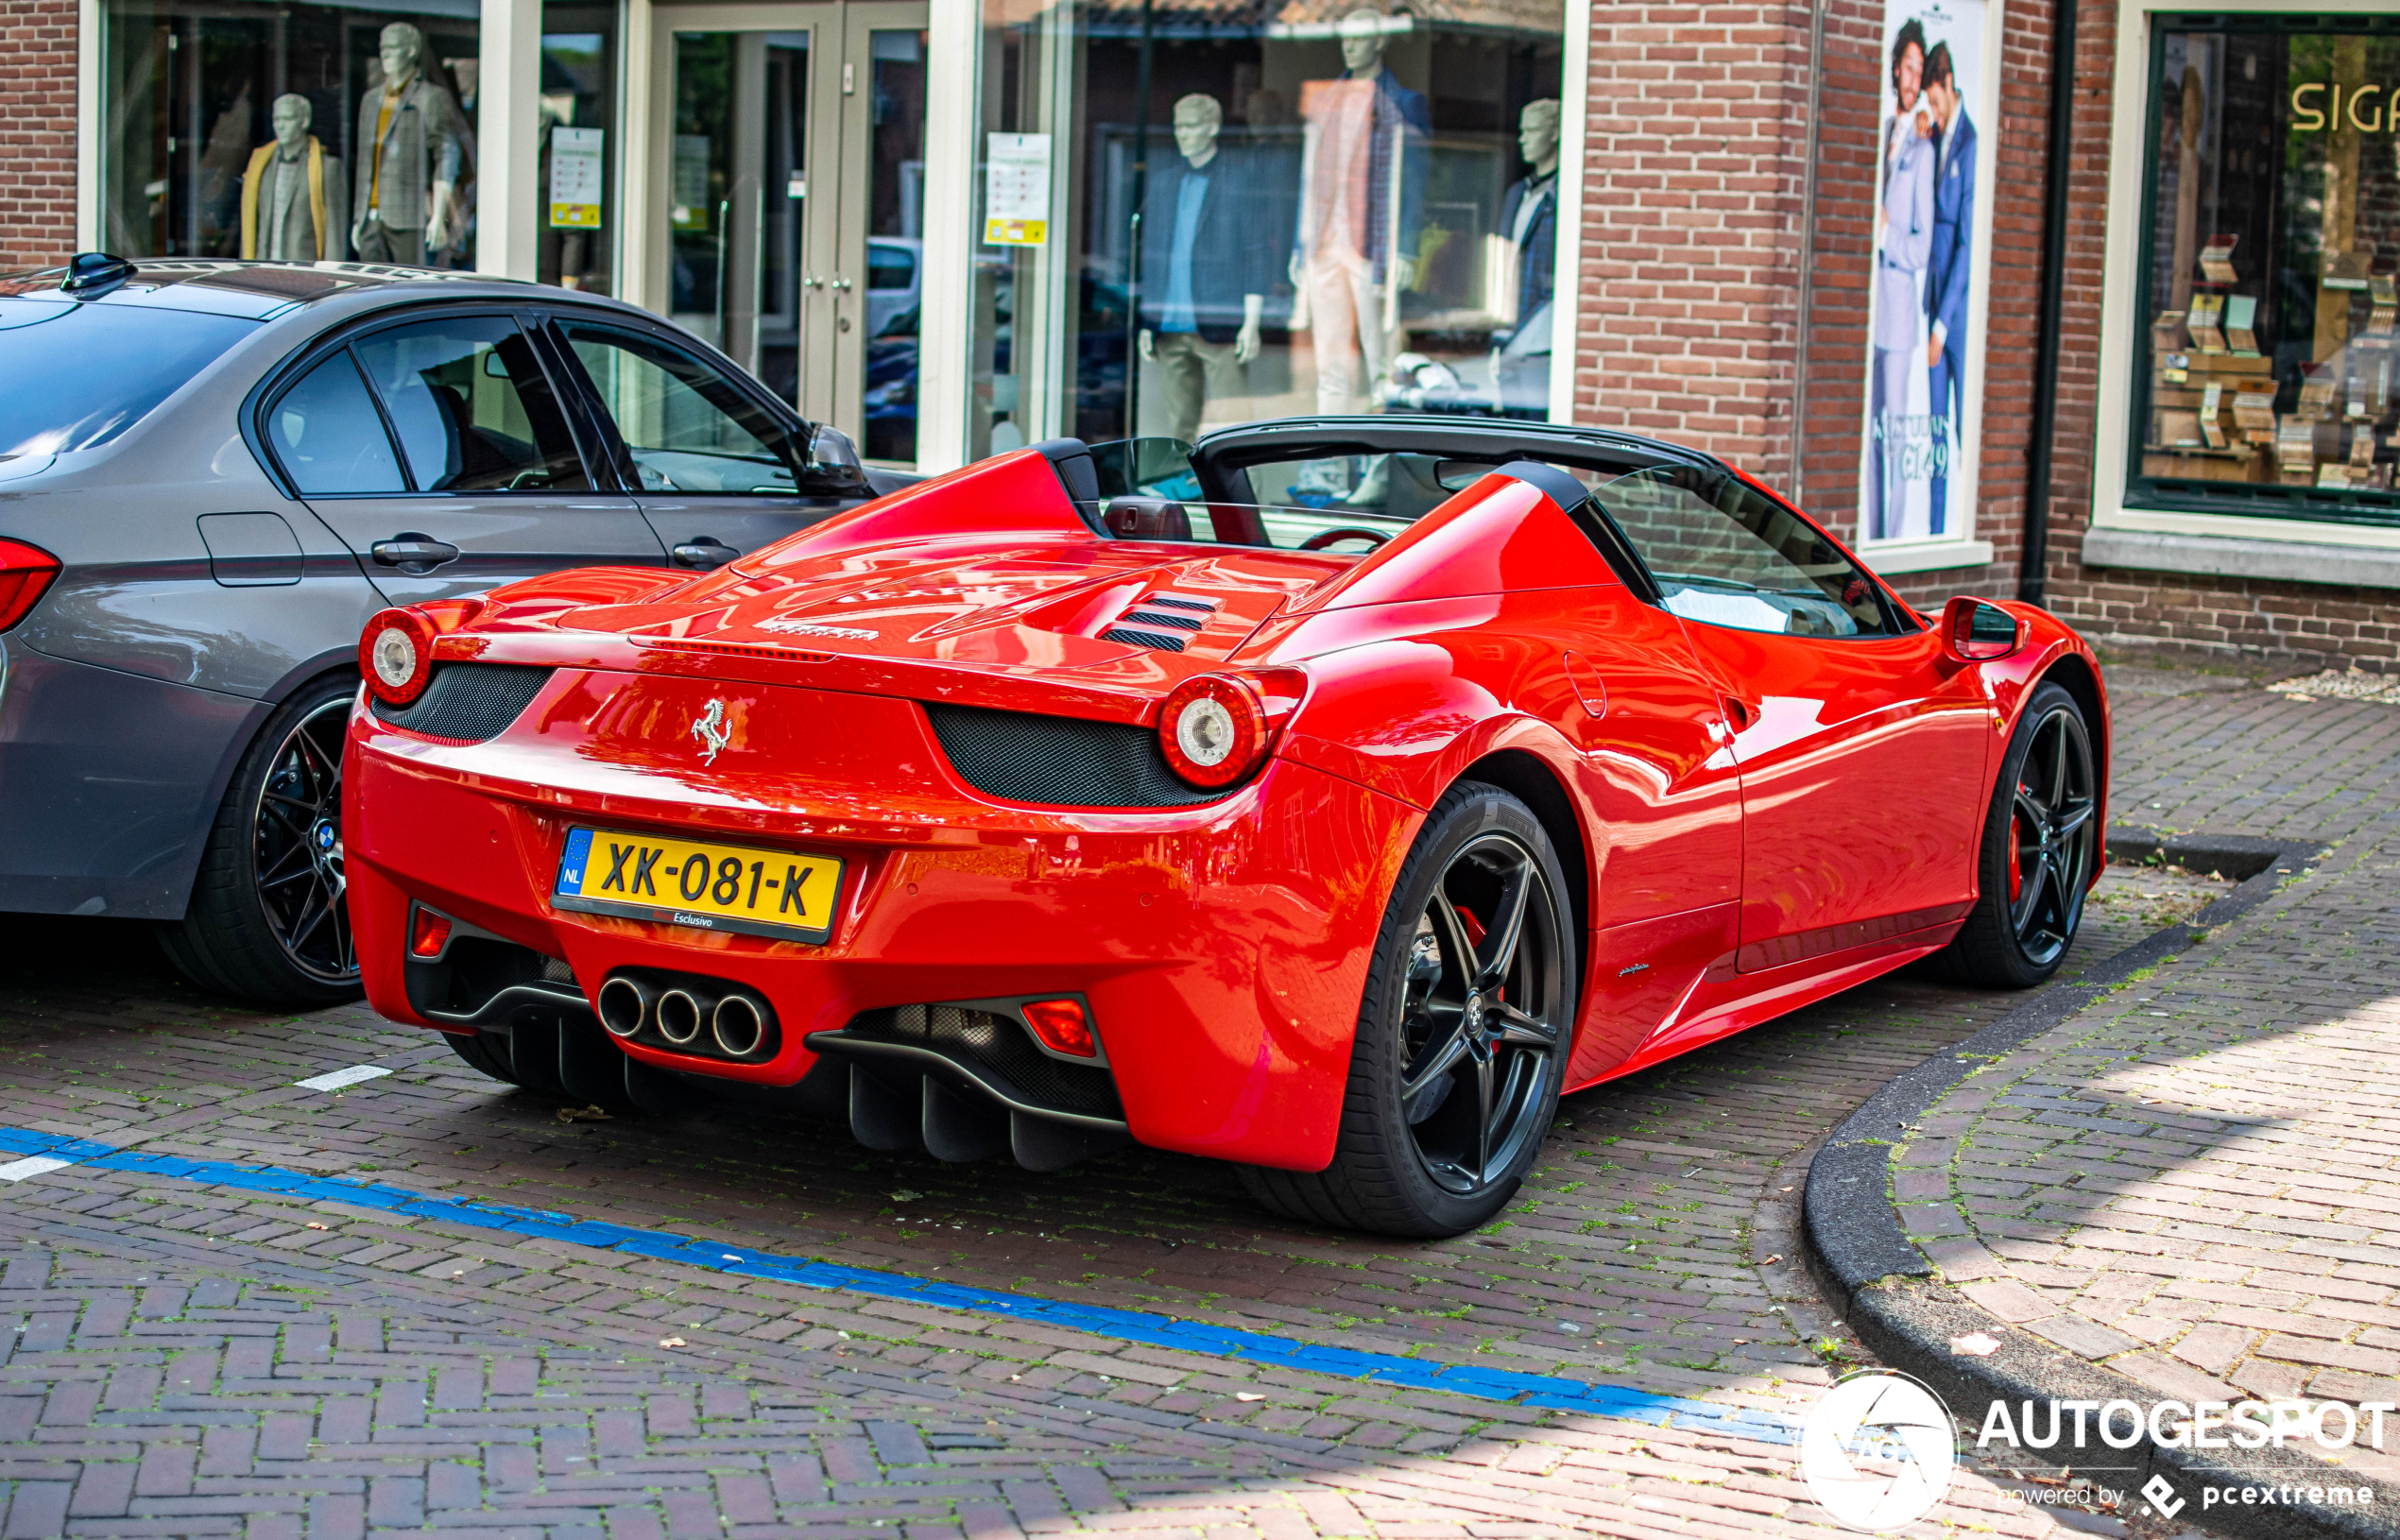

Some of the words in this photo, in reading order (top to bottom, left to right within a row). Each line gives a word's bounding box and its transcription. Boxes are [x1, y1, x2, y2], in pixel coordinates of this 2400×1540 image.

[564, 868, 580, 884] NL
[602, 843, 814, 916] XK-081-K
[674, 912, 713, 927] Esclusivo
